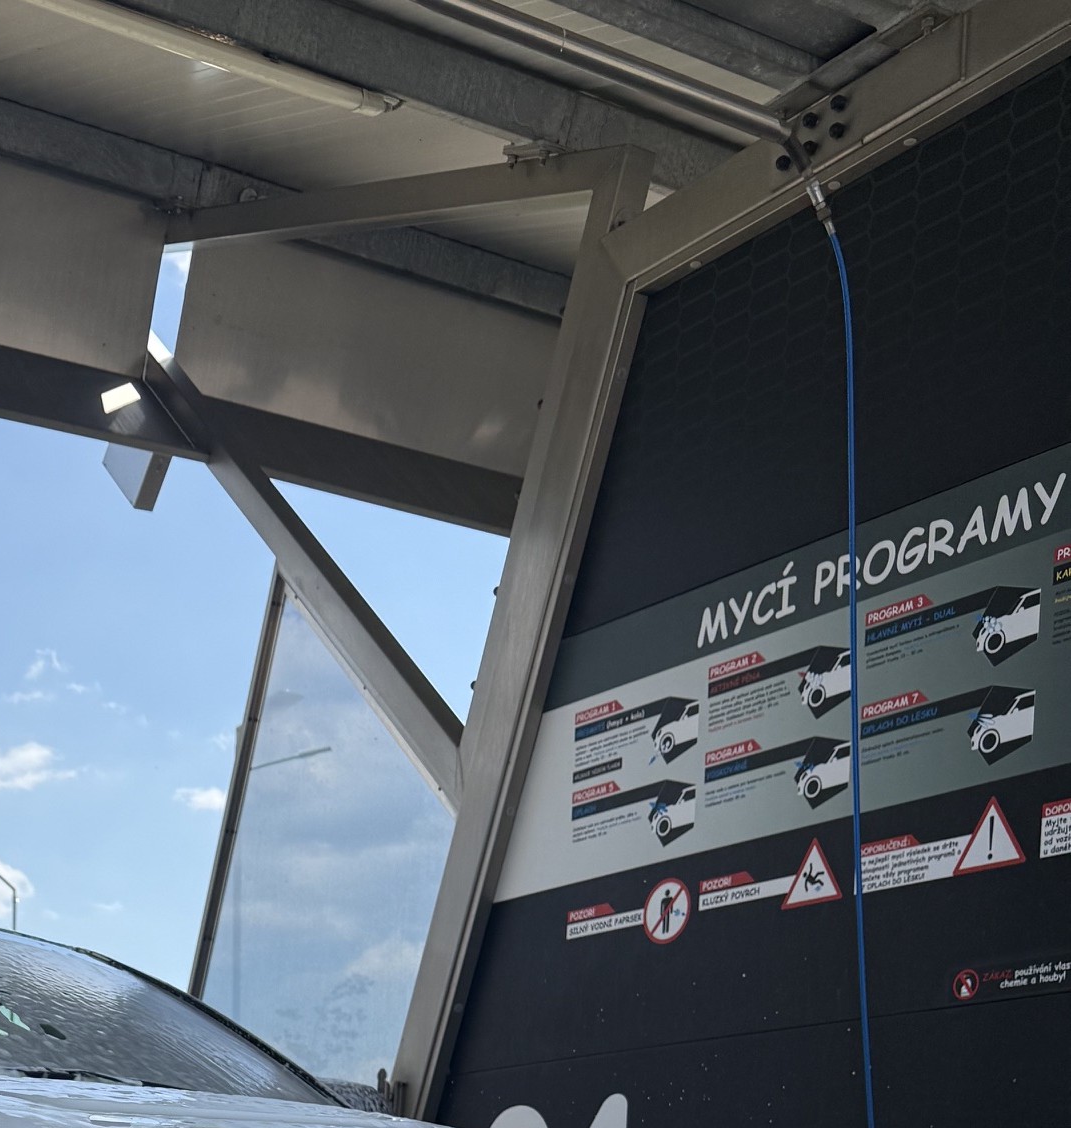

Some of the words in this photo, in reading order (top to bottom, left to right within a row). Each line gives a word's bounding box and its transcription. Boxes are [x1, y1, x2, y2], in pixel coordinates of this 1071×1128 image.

[697, 562, 797, 648] MYCÍ
[814, 473, 1067, 605] PROGRAMY
[867, 600, 914, 624] PROGRAM
[917, 596, 924, 608] 3
[867, 622, 898, 642] HLAVNÍ
[900, 616, 923, 631] MYTÍ
[933, 606, 956, 621] DUAL
[710, 658, 749, 678] PROGRAM
[751, 653, 758, 664] 2
[576, 704, 609, 722] PROGRAM
[863, 695, 909, 718] PROGRAM
[911, 692, 919, 704] 7
[862, 720, 894, 736] OPLACH
[896, 715, 909, 725] DO
[911, 707, 938, 722] LESKU
[706, 743, 745, 763] PROGRAM
[747, 741, 754, 751] 6
[573, 784, 607, 803] PROGRAM
[1045, 818, 1067, 831] Myjte
[1044, 837, 1053, 846] od
[702, 876, 732, 891] POZOR!
[867, 880, 891, 890] OPLACH
[892, 877, 902, 885] DO
[702, 891, 728, 907] KLUZKÝ
[731, 887, 760, 900] POVRCH
[569, 922, 589, 936] SILNÝ
[590, 918, 613, 931] VODNÍ
[614, 912, 642, 926] PAPRSEK
[999, 977, 1029, 989] chemie
[1030, 976, 1037, 985] a
[1039, 970, 1066, 984] houby!
[1014, 961, 1052, 979] používání
